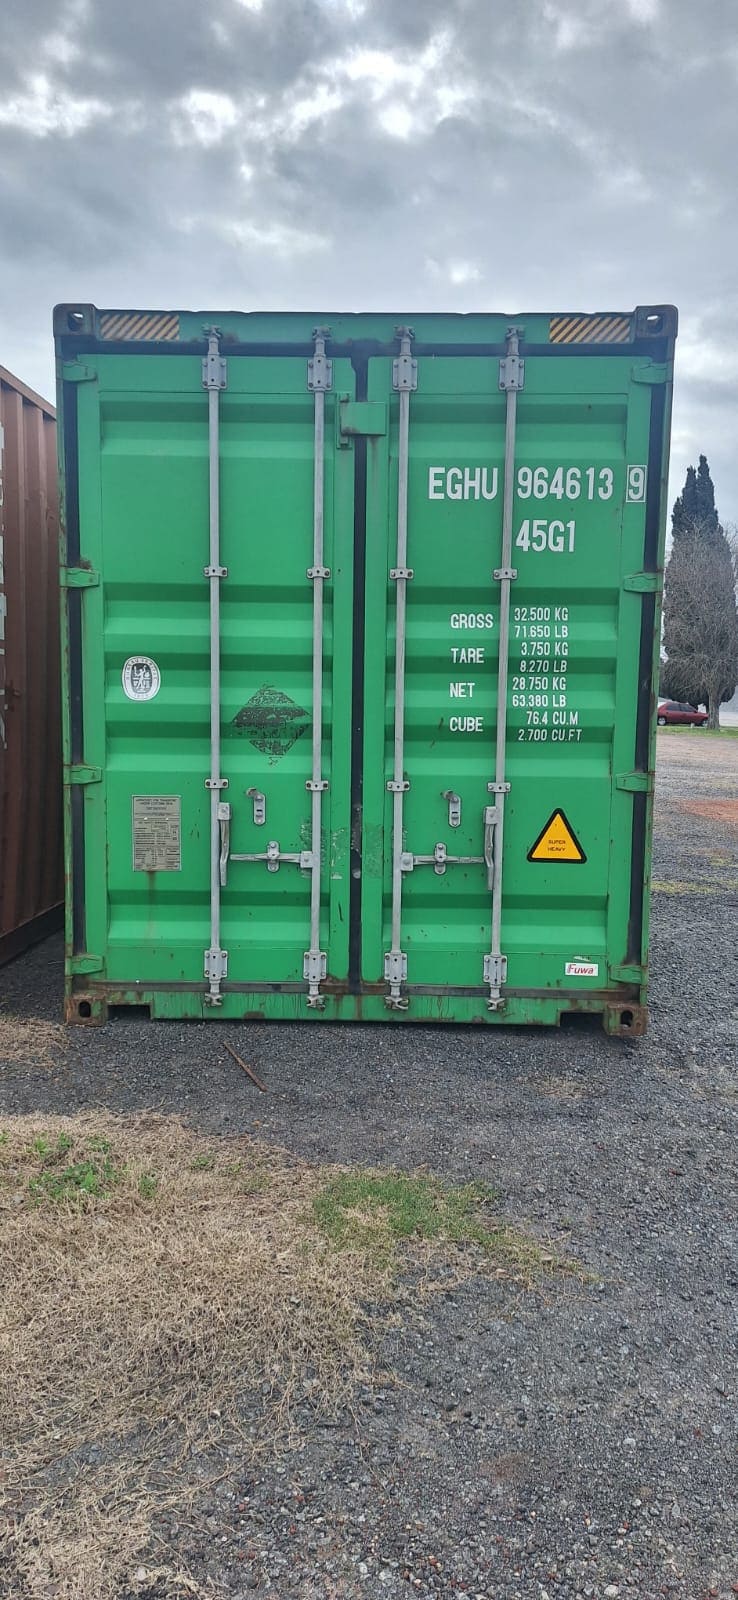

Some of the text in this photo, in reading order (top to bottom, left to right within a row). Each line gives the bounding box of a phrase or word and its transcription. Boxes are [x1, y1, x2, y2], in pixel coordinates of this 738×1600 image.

[428, 466, 645, 500] EGHU 964613 9
[516, 520, 576, 552] 45G1
[450, 614, 493, 628] GROSS
[514, 608, 568, 621] 32.500 KG
[514, 626, 568, 638] 71.650 LB
[451, 648, 484, 663] TARE
[521, 642, 568, 656] 3.750 KG
[520, 660, 567, 672] 8.270 LB
[450, 683, 475, 698] NET
[512, 677, 566, 690] 28.750 KG
[512, 695, 566, 707] 63.380 LB
[450, 717, 483, 732] CUBE
[526, 711, 578, 725] 76.4 CU.M
[518, 729, 582, 740] 2.700 CU.FT
[567, 963, 594, 975] Fuwa
